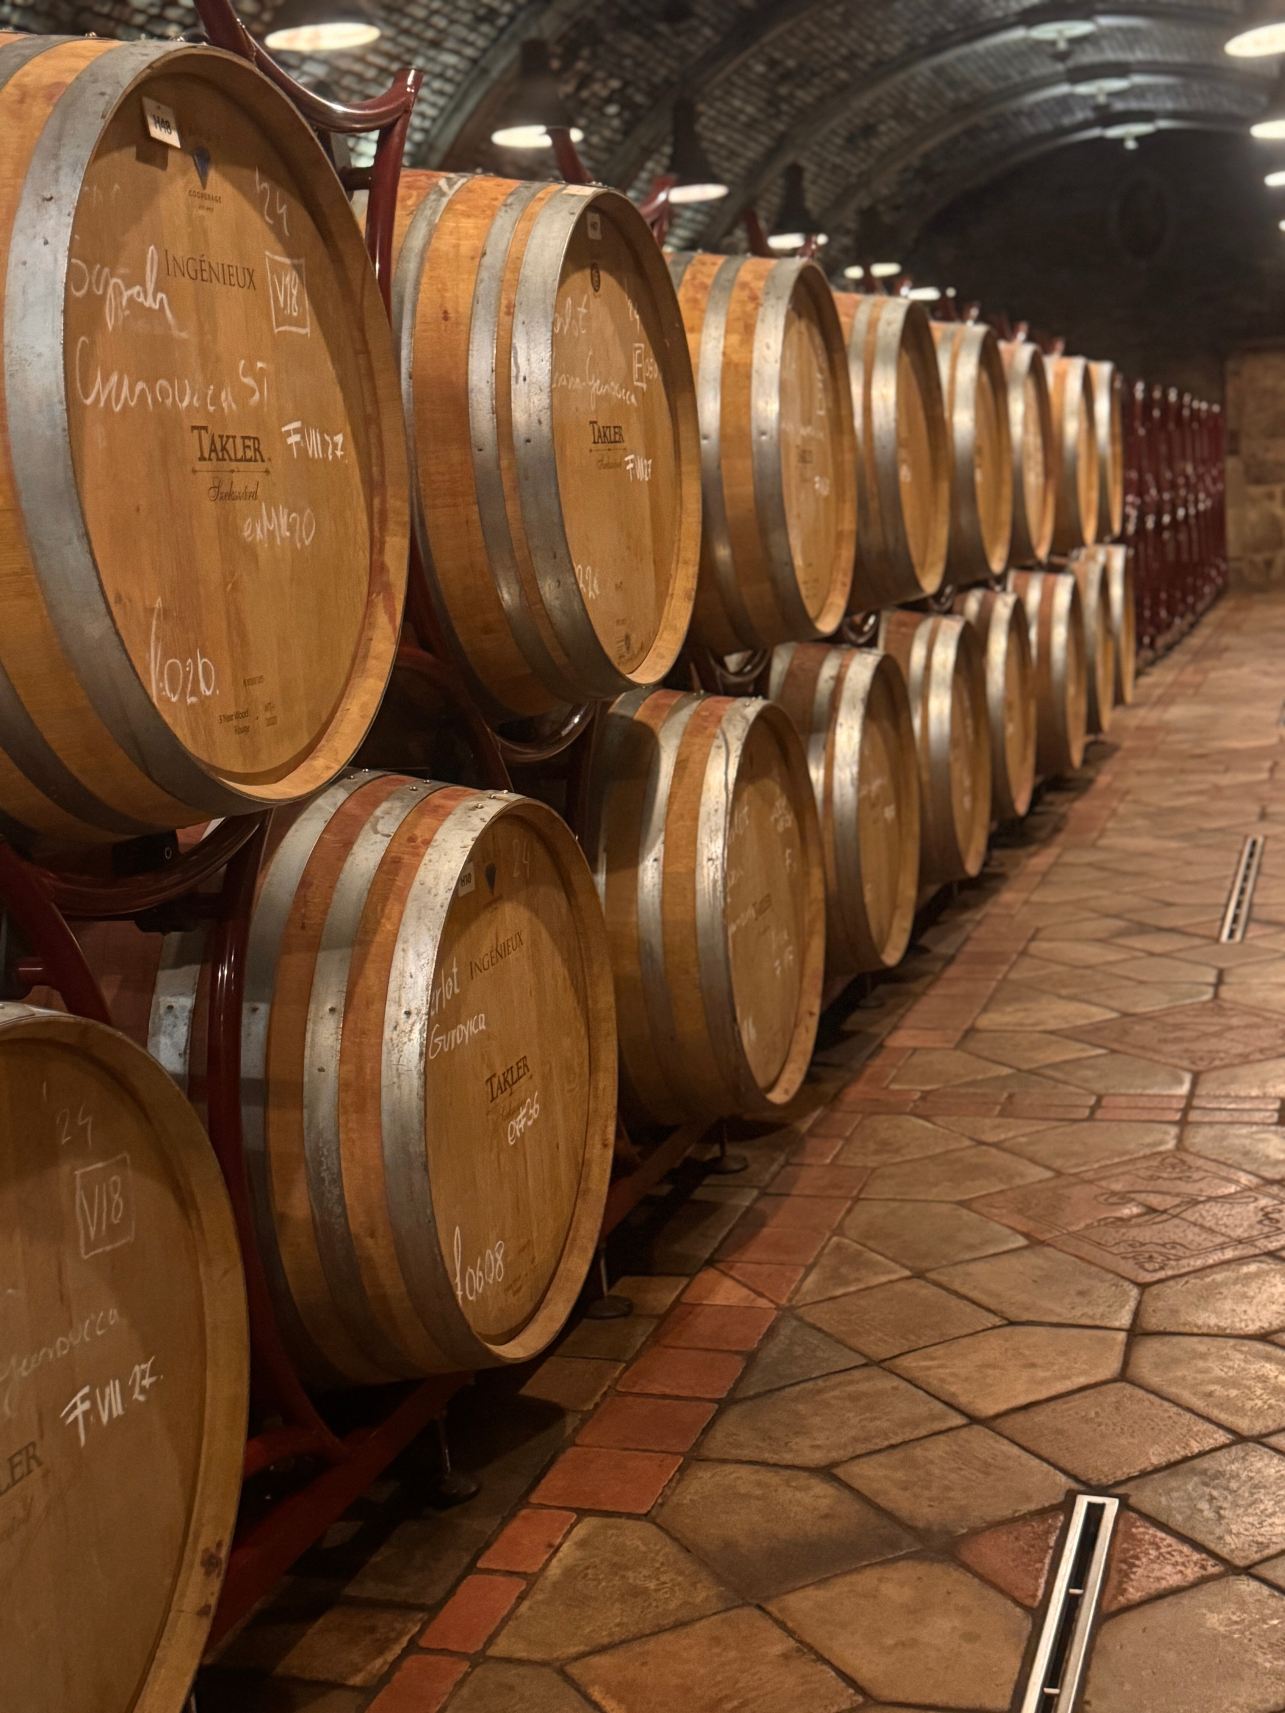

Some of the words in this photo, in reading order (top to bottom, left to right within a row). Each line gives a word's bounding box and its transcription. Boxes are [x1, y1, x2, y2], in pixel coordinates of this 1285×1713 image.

[163, 249, 256, 291] INGÉNIEUX
[191, 425, 266, 463] TAKLER
[589, 420, 625, 445] TAKLER
[485, 1055, 530, 1104] TAKLER
